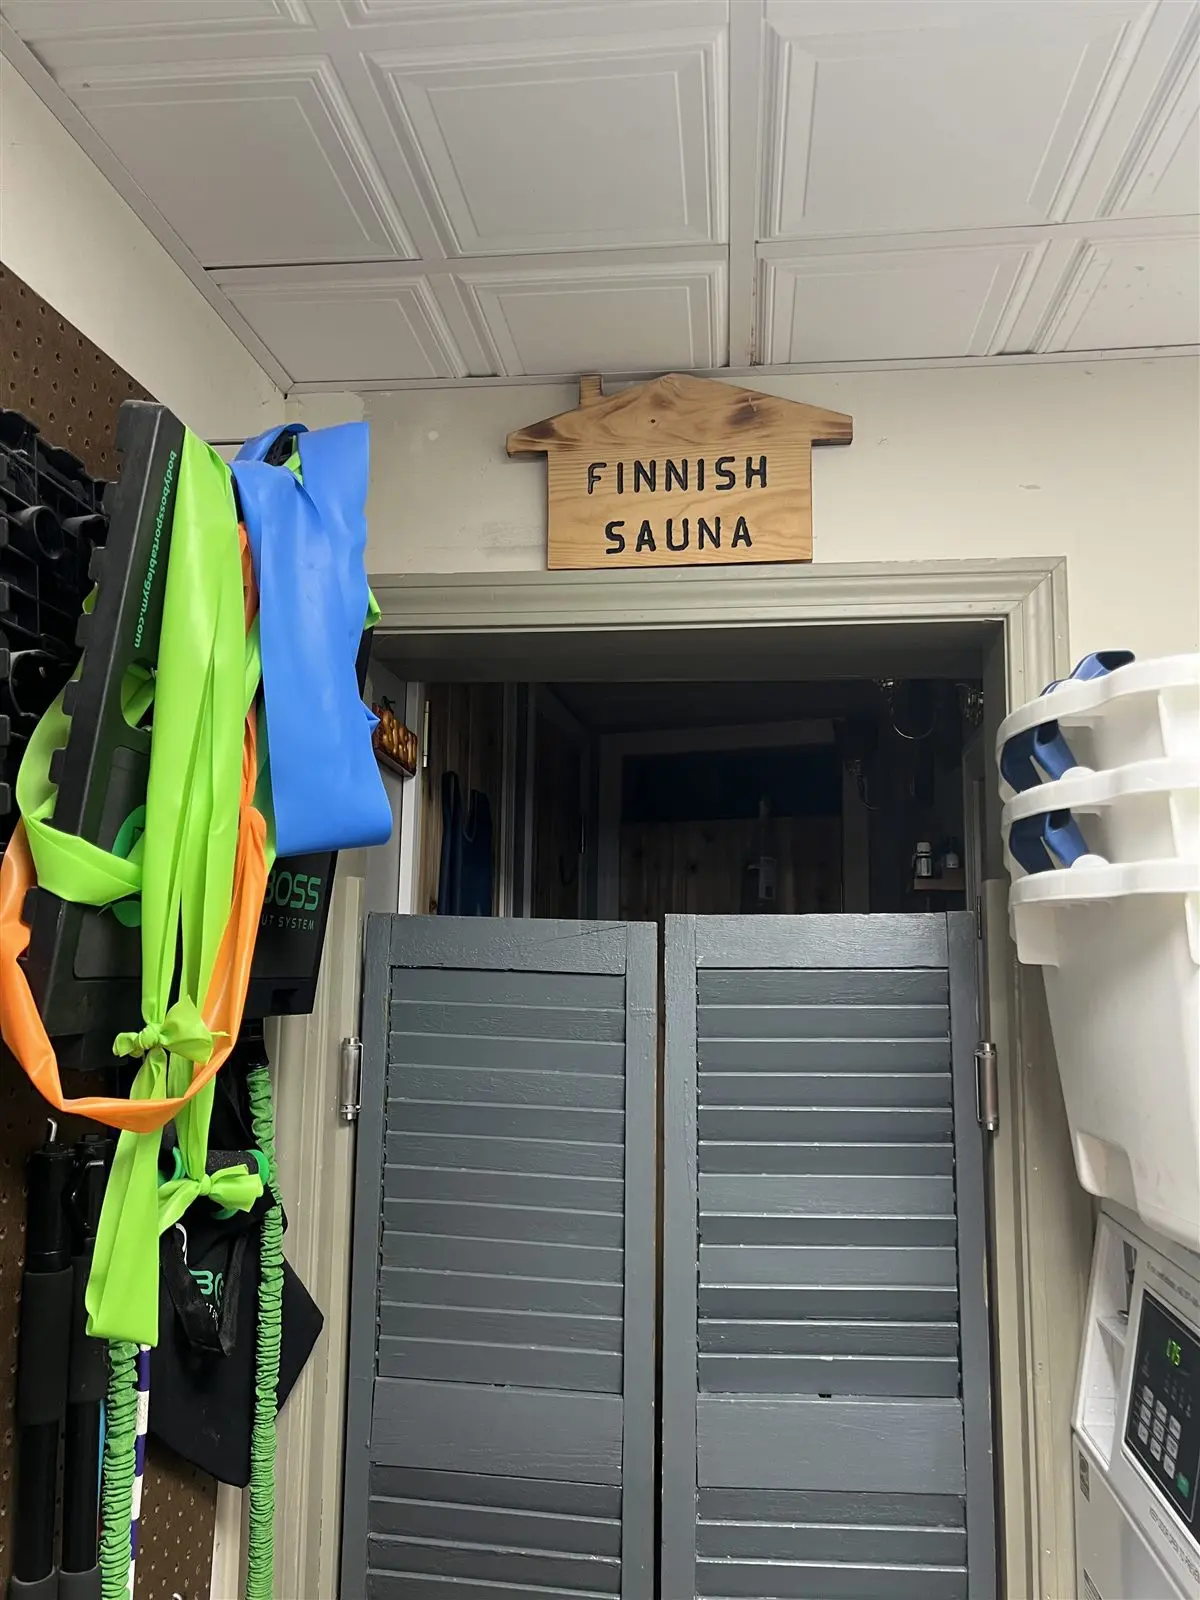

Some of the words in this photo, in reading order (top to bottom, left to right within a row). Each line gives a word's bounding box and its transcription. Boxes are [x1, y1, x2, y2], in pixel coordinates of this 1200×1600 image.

[587, 455, 767, 495] FINNISH
[134, 450, 177, 648] bodybossportablegym.com
[605, 516, 752, 554] SAUNA
[278, 916, 314, 930] SYSTEM
